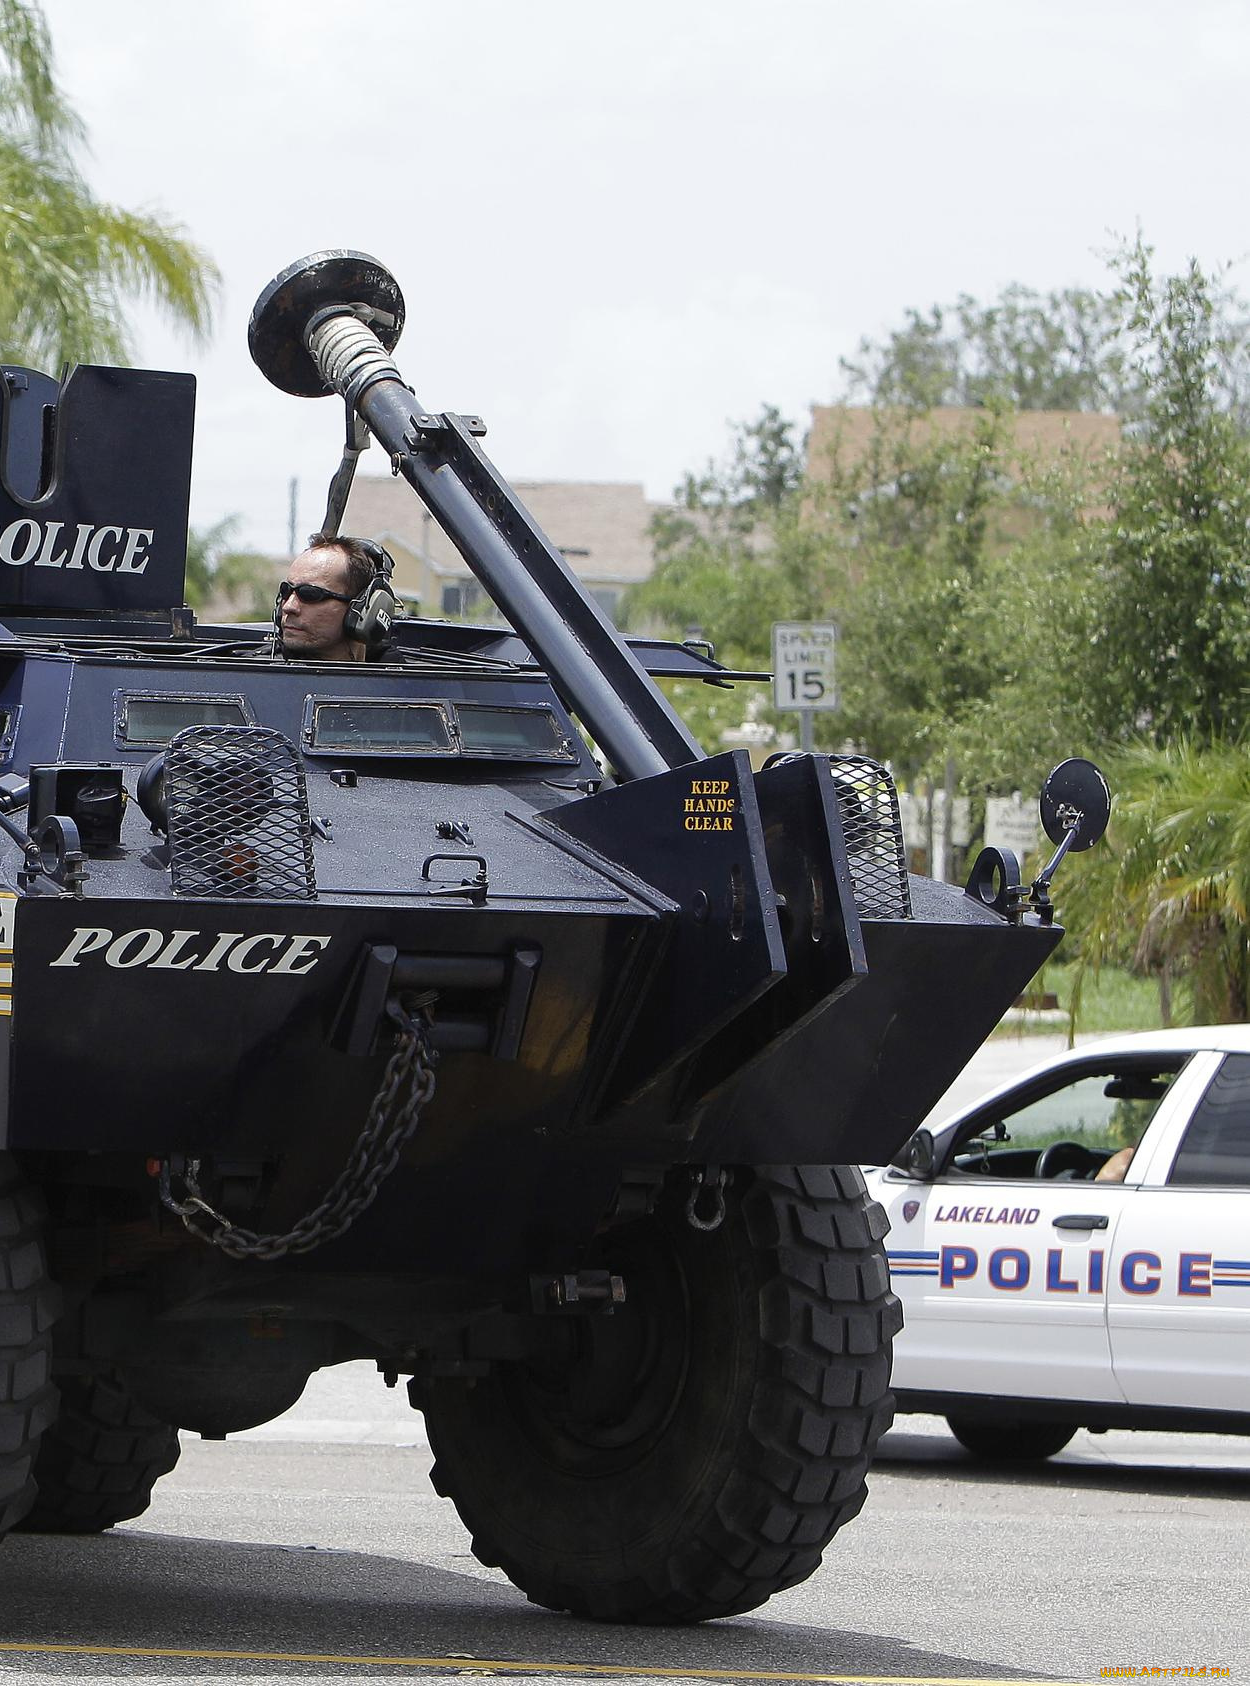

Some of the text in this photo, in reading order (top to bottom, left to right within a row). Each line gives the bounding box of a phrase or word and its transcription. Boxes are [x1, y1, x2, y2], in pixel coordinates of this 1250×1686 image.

[778, 631, 832, 646] SPEED
[784, 650, 826, 664] LIMIT
[787, 669, 825, 700] 15
[691, 780, 730, 795] KEEP
[683, 798, 735, 813] HANDS
[684, 816, 734, 831] CLEAR
[49, 926, 332, 976] POLICE
[934, 1205, 1041, 1226] LAKELAND
[939, 1244, 1214, 1298] POLICE
